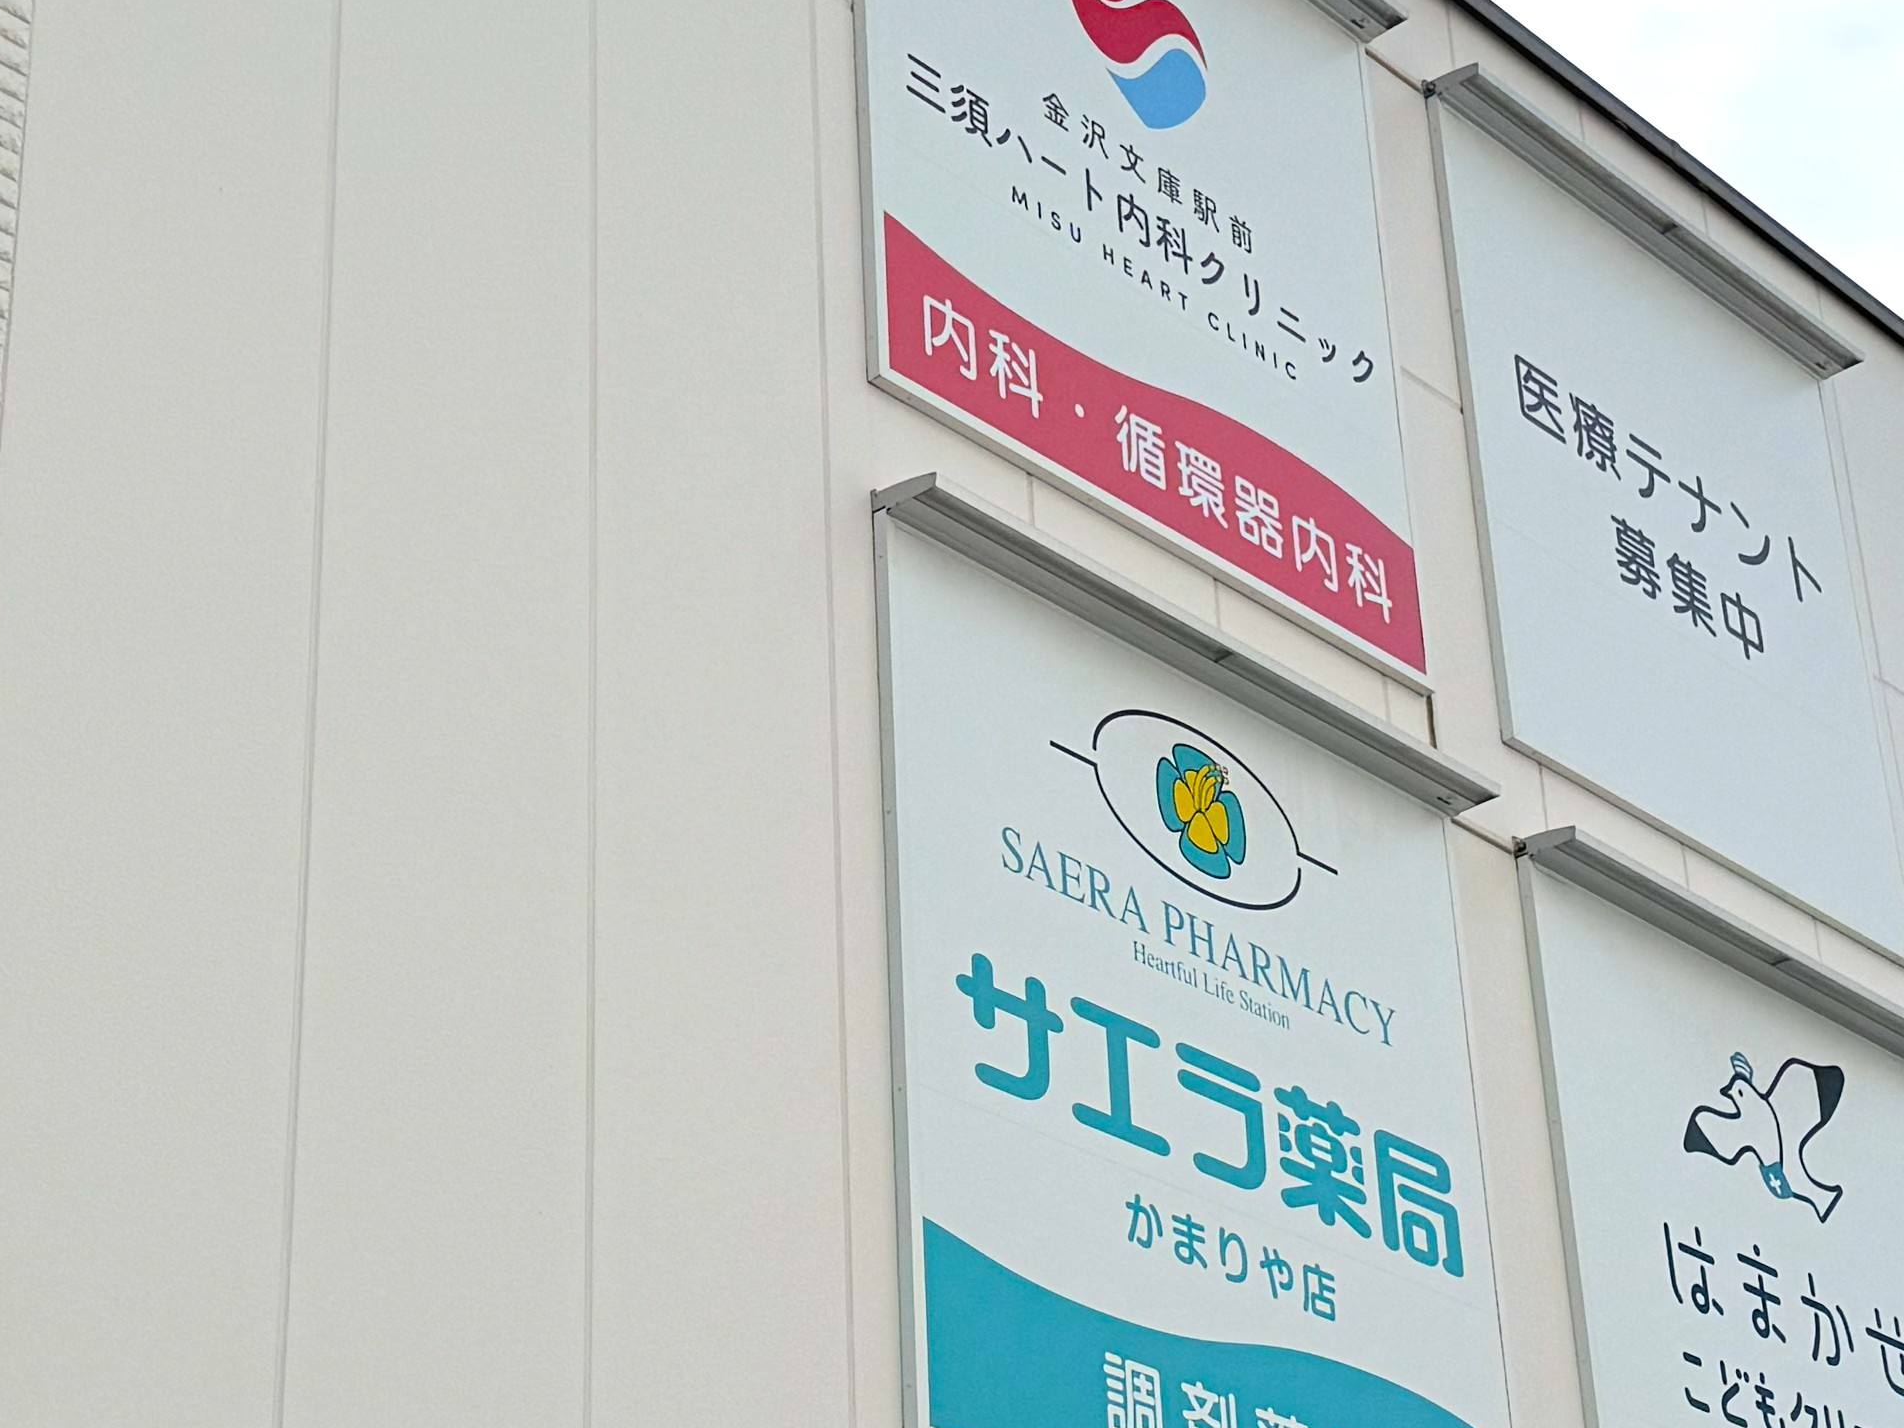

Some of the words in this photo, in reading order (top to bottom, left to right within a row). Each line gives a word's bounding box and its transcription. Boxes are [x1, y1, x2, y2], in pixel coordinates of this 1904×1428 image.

[906, 53, 1374, 383] 三須ハート内科クリニック
[1042, 93, 1253, 254] 金沢文庫駅前
[1011, 185, 1083, 243] MISU
[1102, 247, 1189, 311] HEART
[1208, 312, 1297, 381] CLINIC
[922, 295, 1392, 624] 内科・循環器内科
[1514, 354, 1822, 602] 医療テナント
[1610, 514, 1764, 660] 募集中
[1001, 826, 1149, 934] SAERA
[1161, 900, 1396, 1046] PHARMACY
[1133, 940, 1197, 988] Heartful
[1203, 972, 1235, 1004] Life
[1240, 991, 1290, 1030] Station
[955, 953, 1464, 1278] サエラ薬局
[1126, 1194, 1337, 1322] かまりや店
